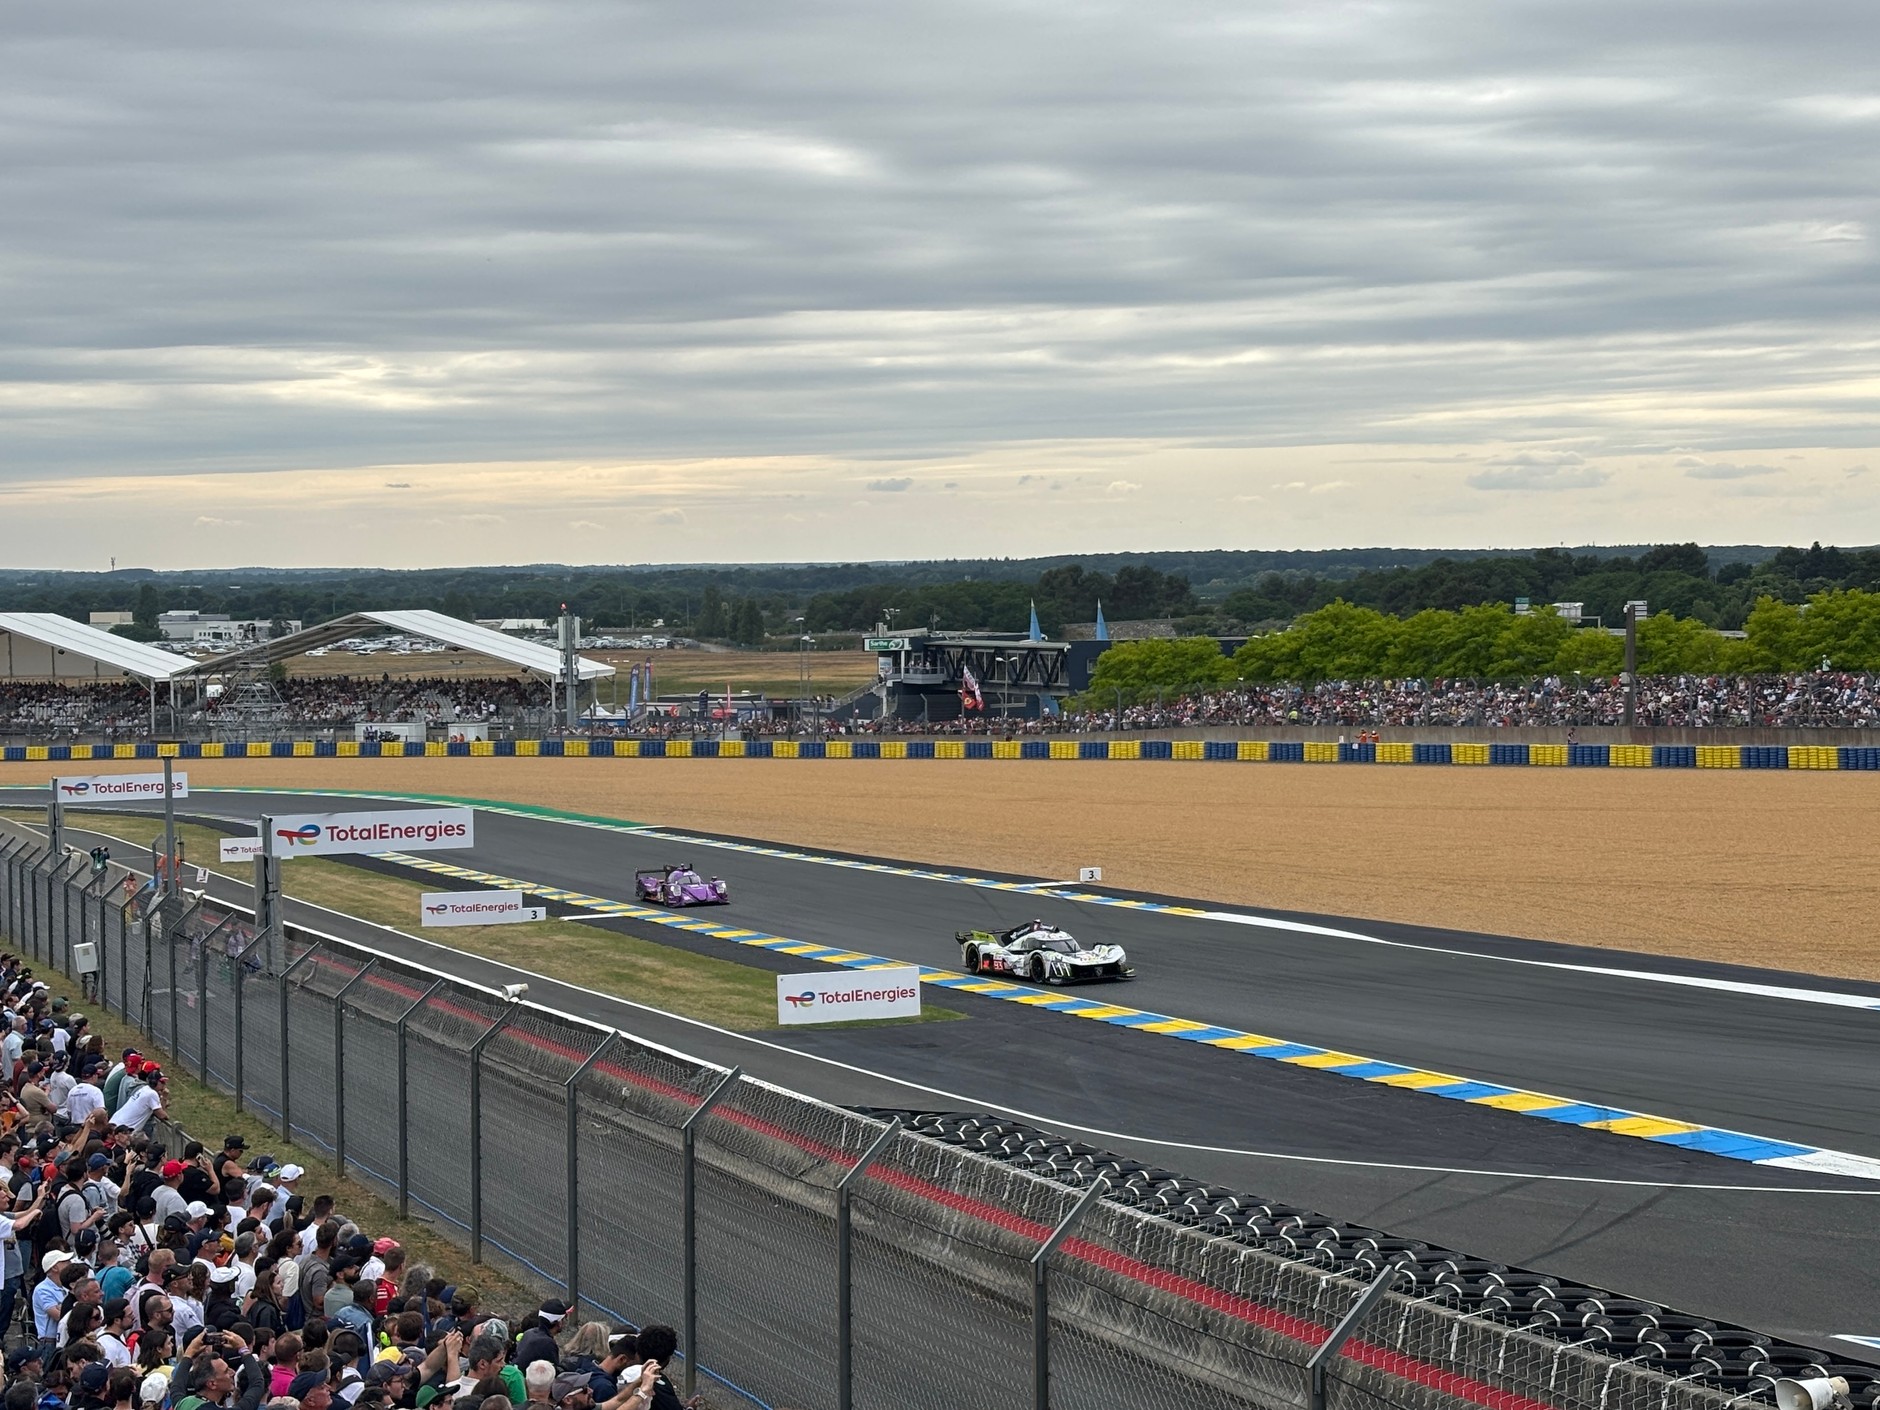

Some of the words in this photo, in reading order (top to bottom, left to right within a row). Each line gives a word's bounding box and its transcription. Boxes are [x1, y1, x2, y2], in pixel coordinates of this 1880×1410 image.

[92, 781, 183, 794] TotalEnerges
[325, 820, 466, 842] TotalEnergies
[1088, 870, 1094, 879] 3
[450, 902, 519, 913] TotalEnergies
[531, 910, 538, 919] 3
[994, 961, 1003, 970] 93
[818, 986, 916, 1004] TotalEnergies
